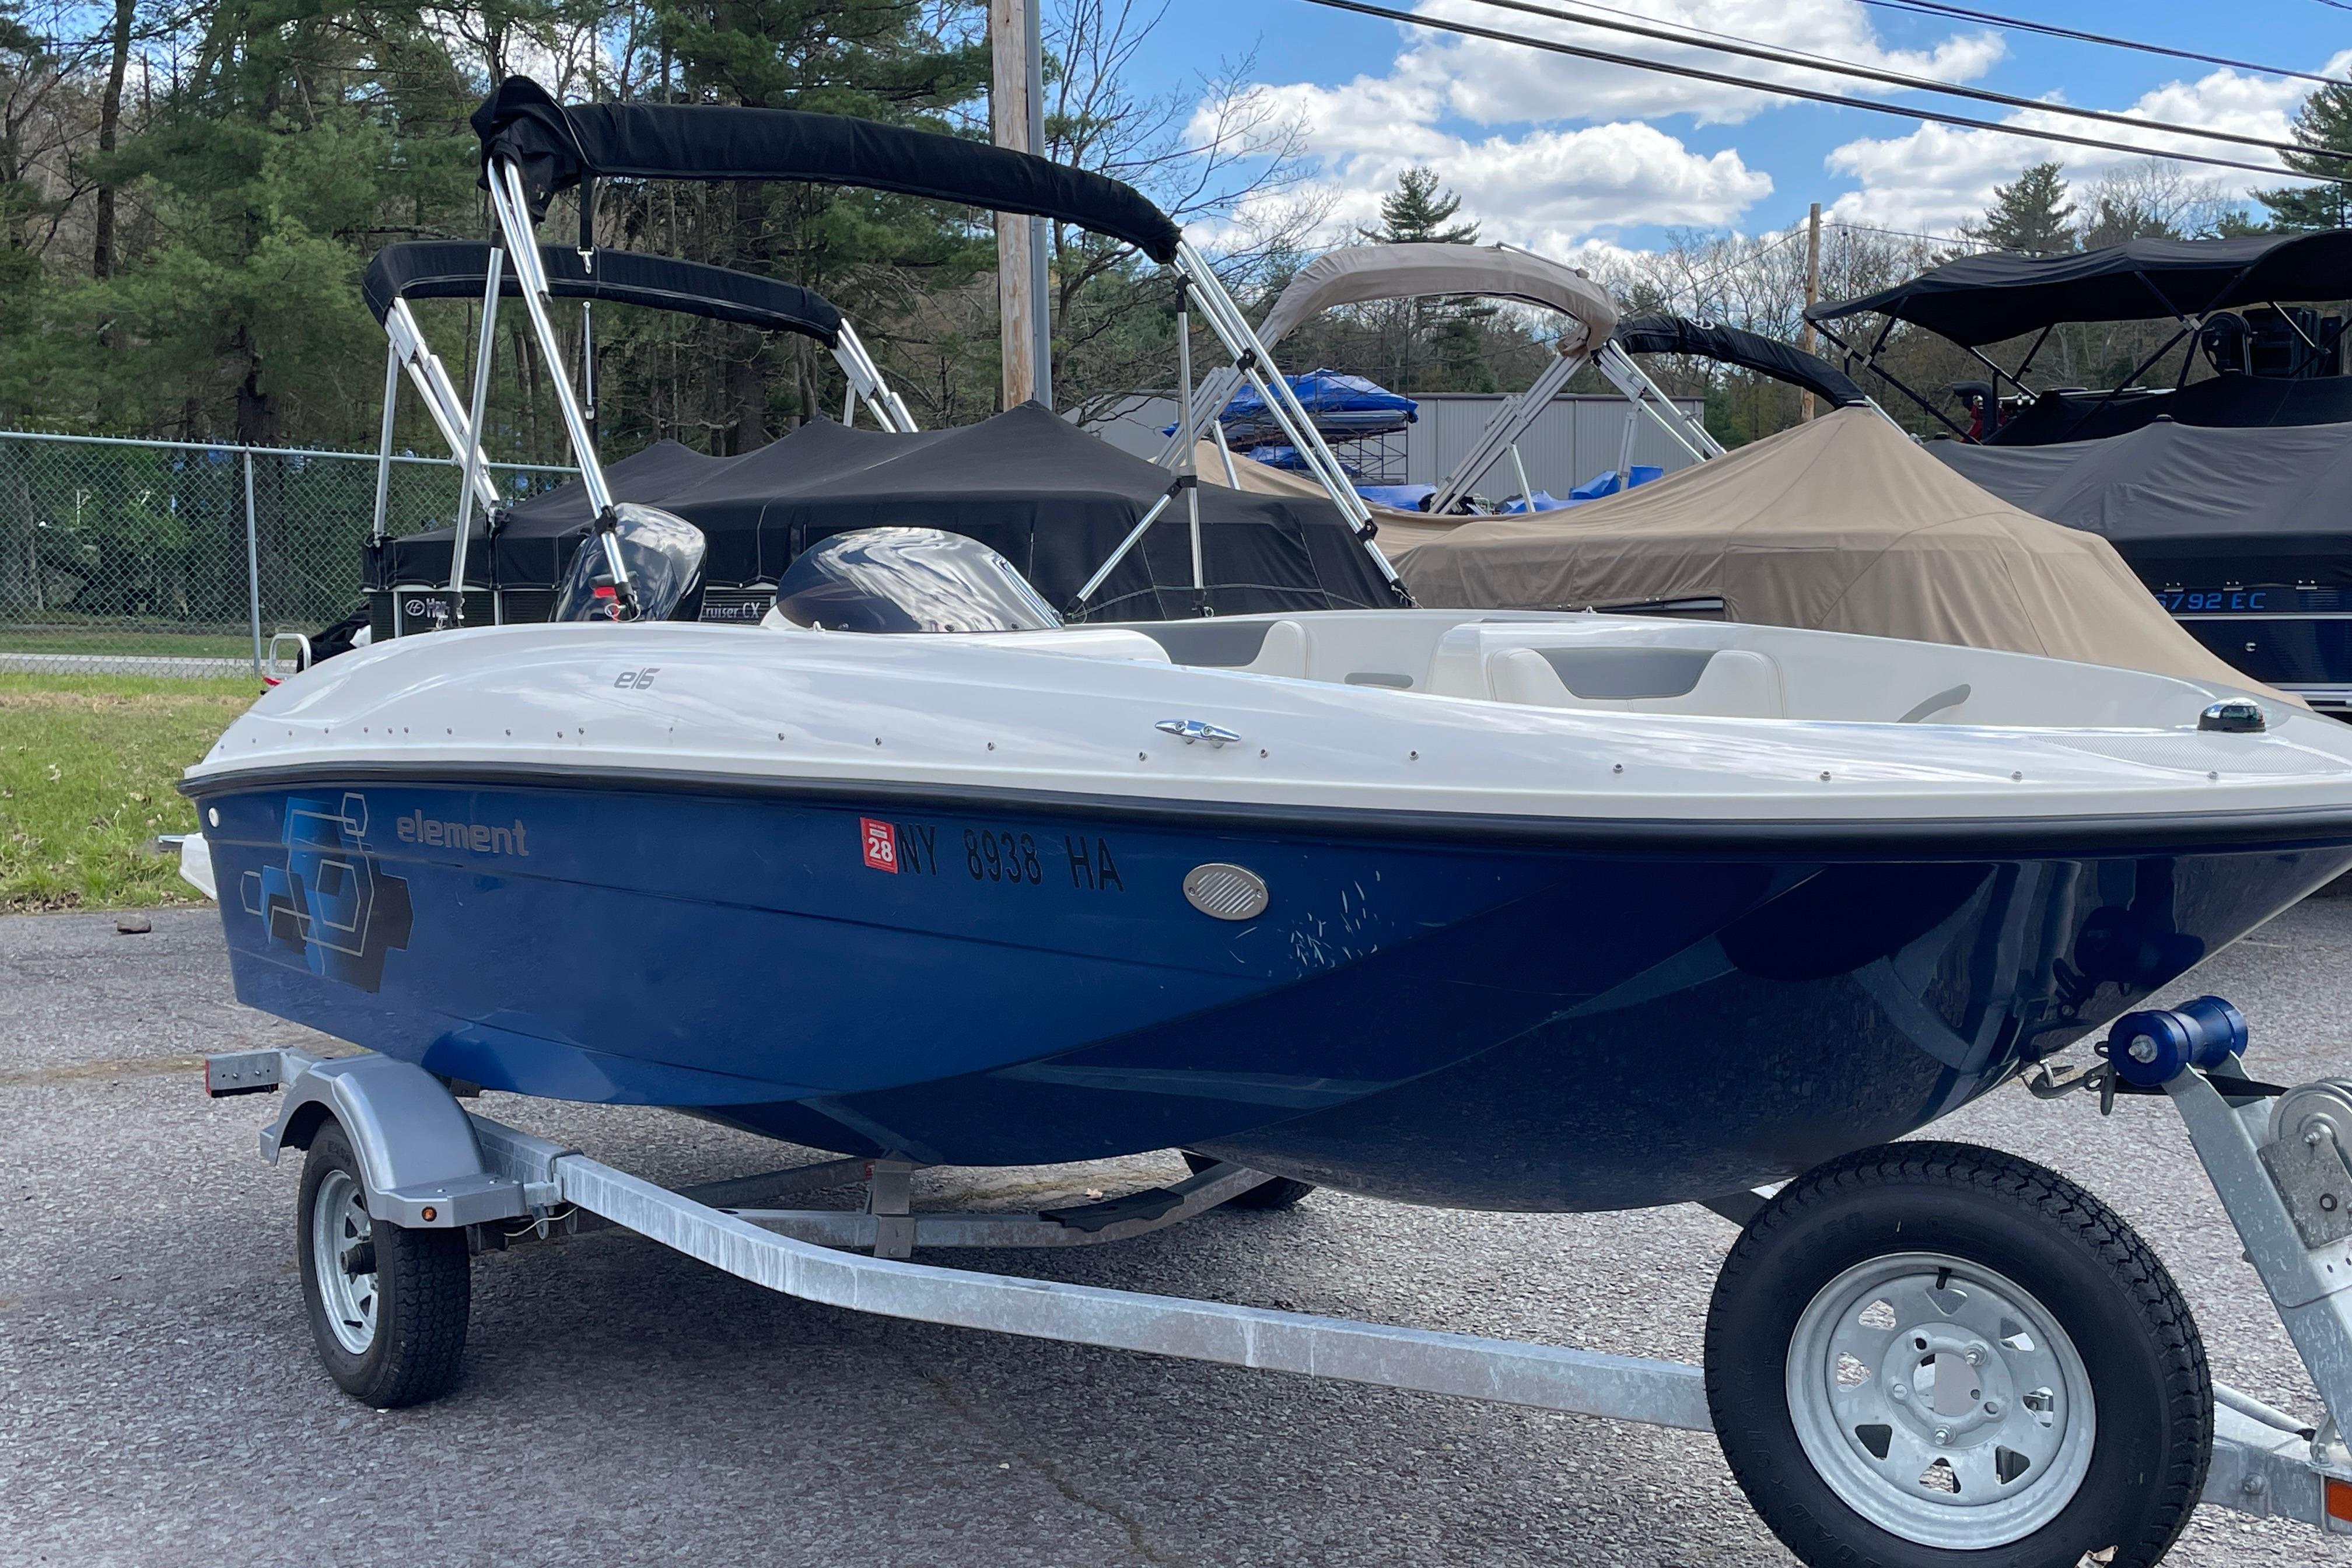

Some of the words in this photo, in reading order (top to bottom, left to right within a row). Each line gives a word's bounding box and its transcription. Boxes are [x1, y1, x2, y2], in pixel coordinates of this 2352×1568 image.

[742, 602, 761, 618] CX
[2231, 592, 2266, 610] EC
[396, 808, 530, 857] element
[868, 836, 894, 863] 28
[895, 822, 937, 876] NY
[964, 828, 1043, 886] 8938
[1064, 834, 1124, 892] HA
